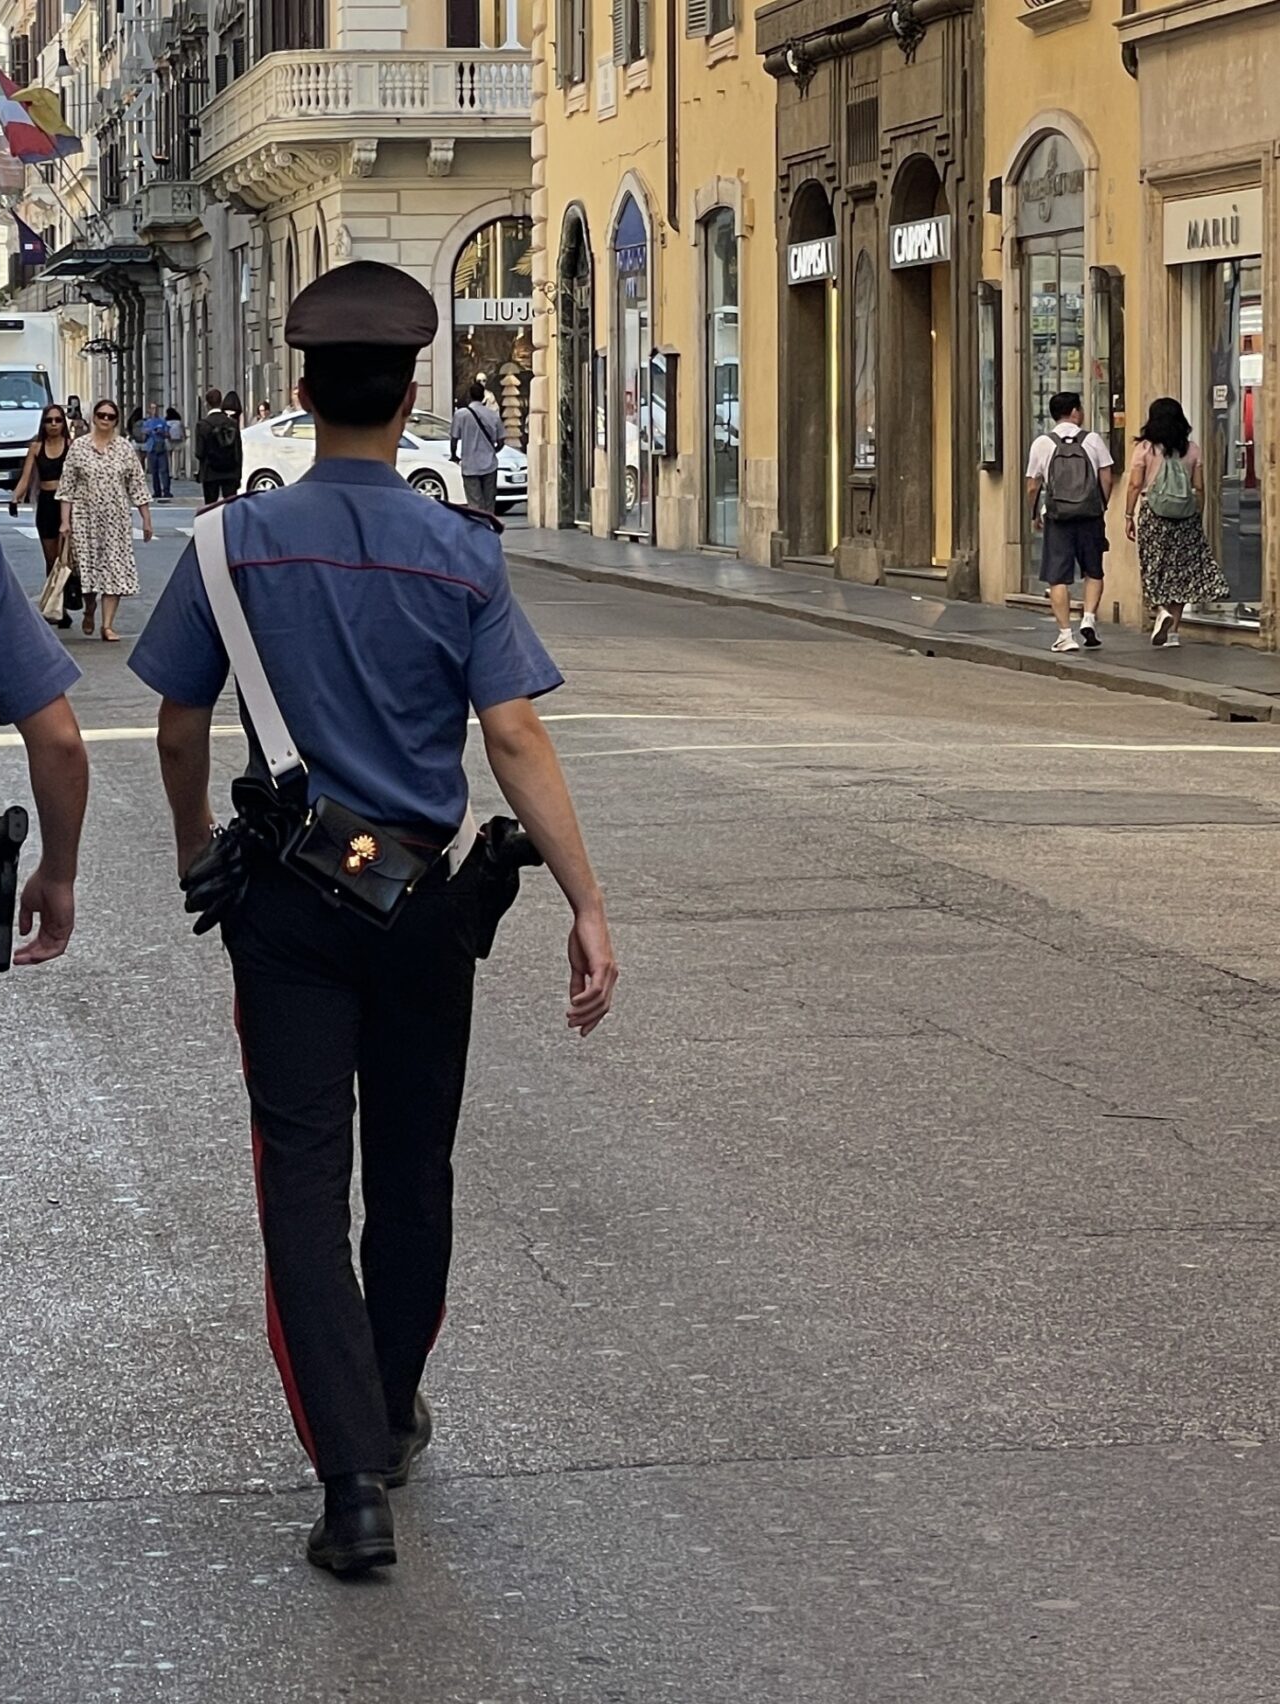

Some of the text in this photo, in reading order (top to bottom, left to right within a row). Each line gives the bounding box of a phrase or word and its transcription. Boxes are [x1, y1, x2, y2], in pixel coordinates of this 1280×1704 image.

[893, 222, 937, 264] CARPISA
[1187, 204, 1240, 250] MARLÙ
[790, 242, 827, 280] CARPISA
